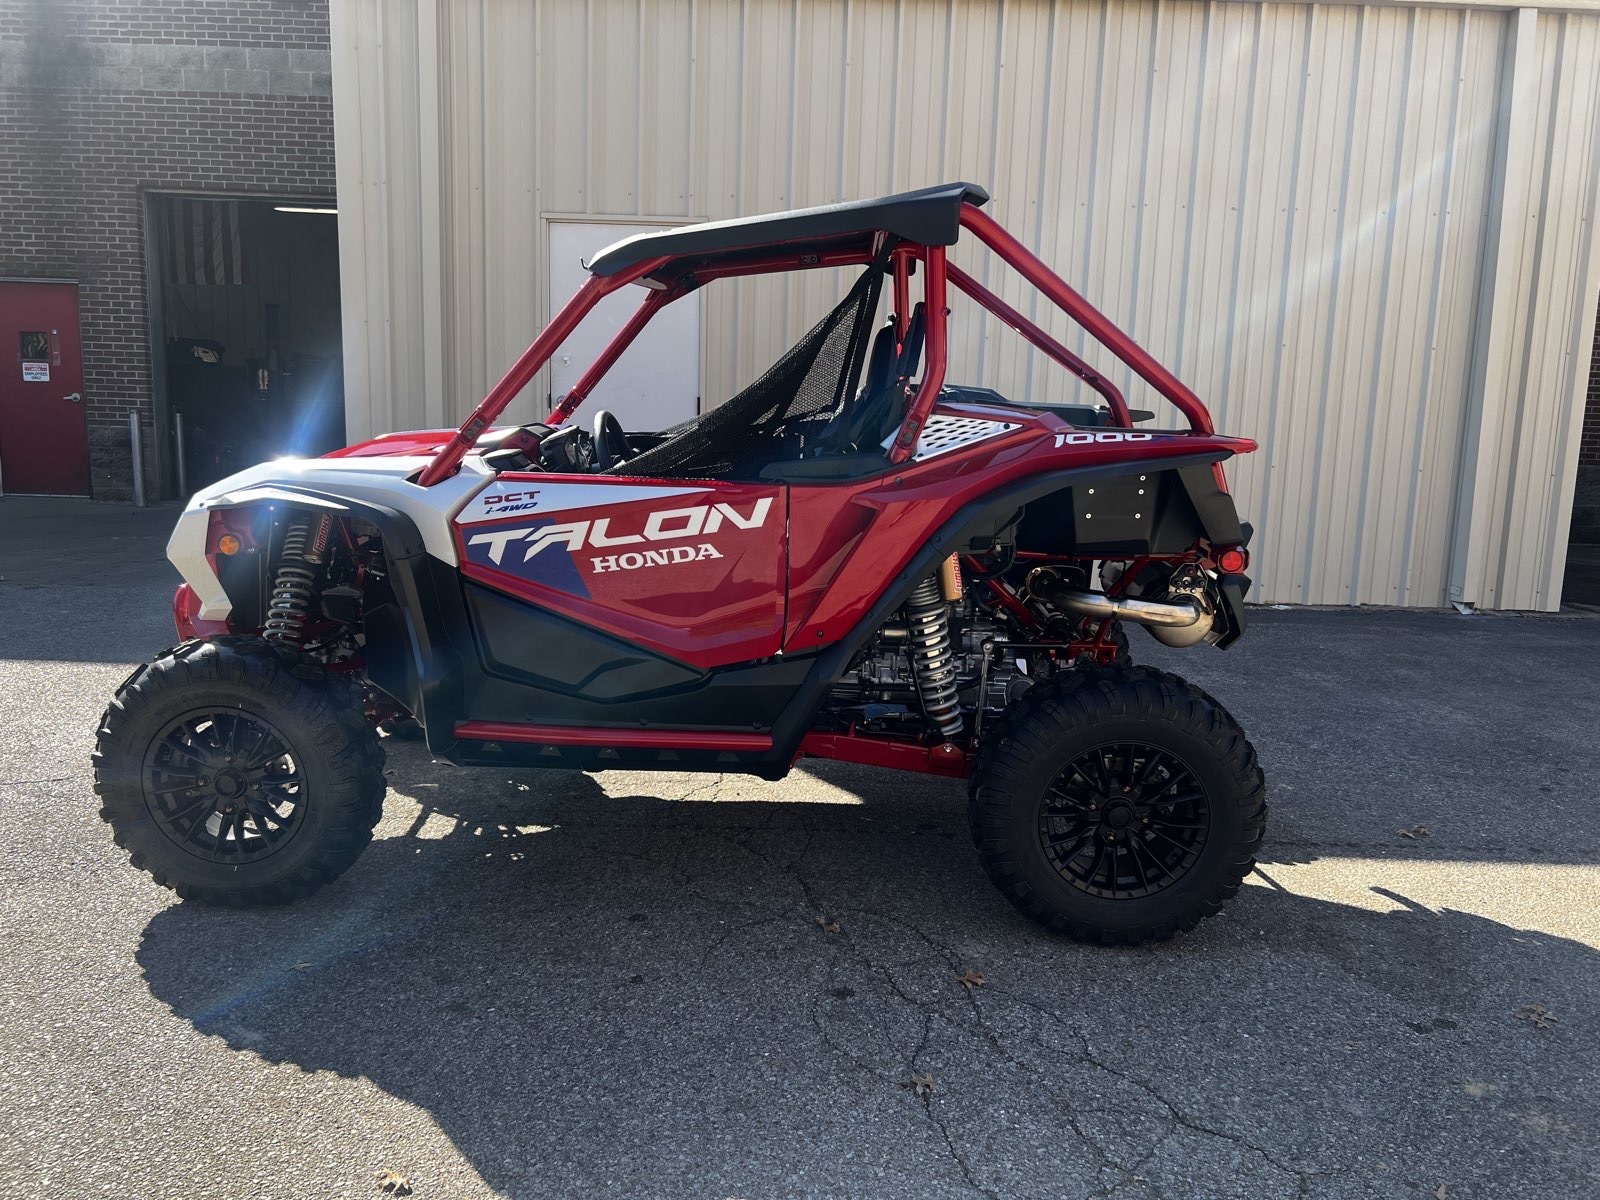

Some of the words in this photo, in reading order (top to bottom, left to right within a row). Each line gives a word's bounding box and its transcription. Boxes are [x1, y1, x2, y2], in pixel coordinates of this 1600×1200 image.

[484, 490, 541, 505] DCT
[315, 514, 331, 551] SHOWA
[467, 497, 773, 566] TALON
[590, 543, 723, 573] HONDA
